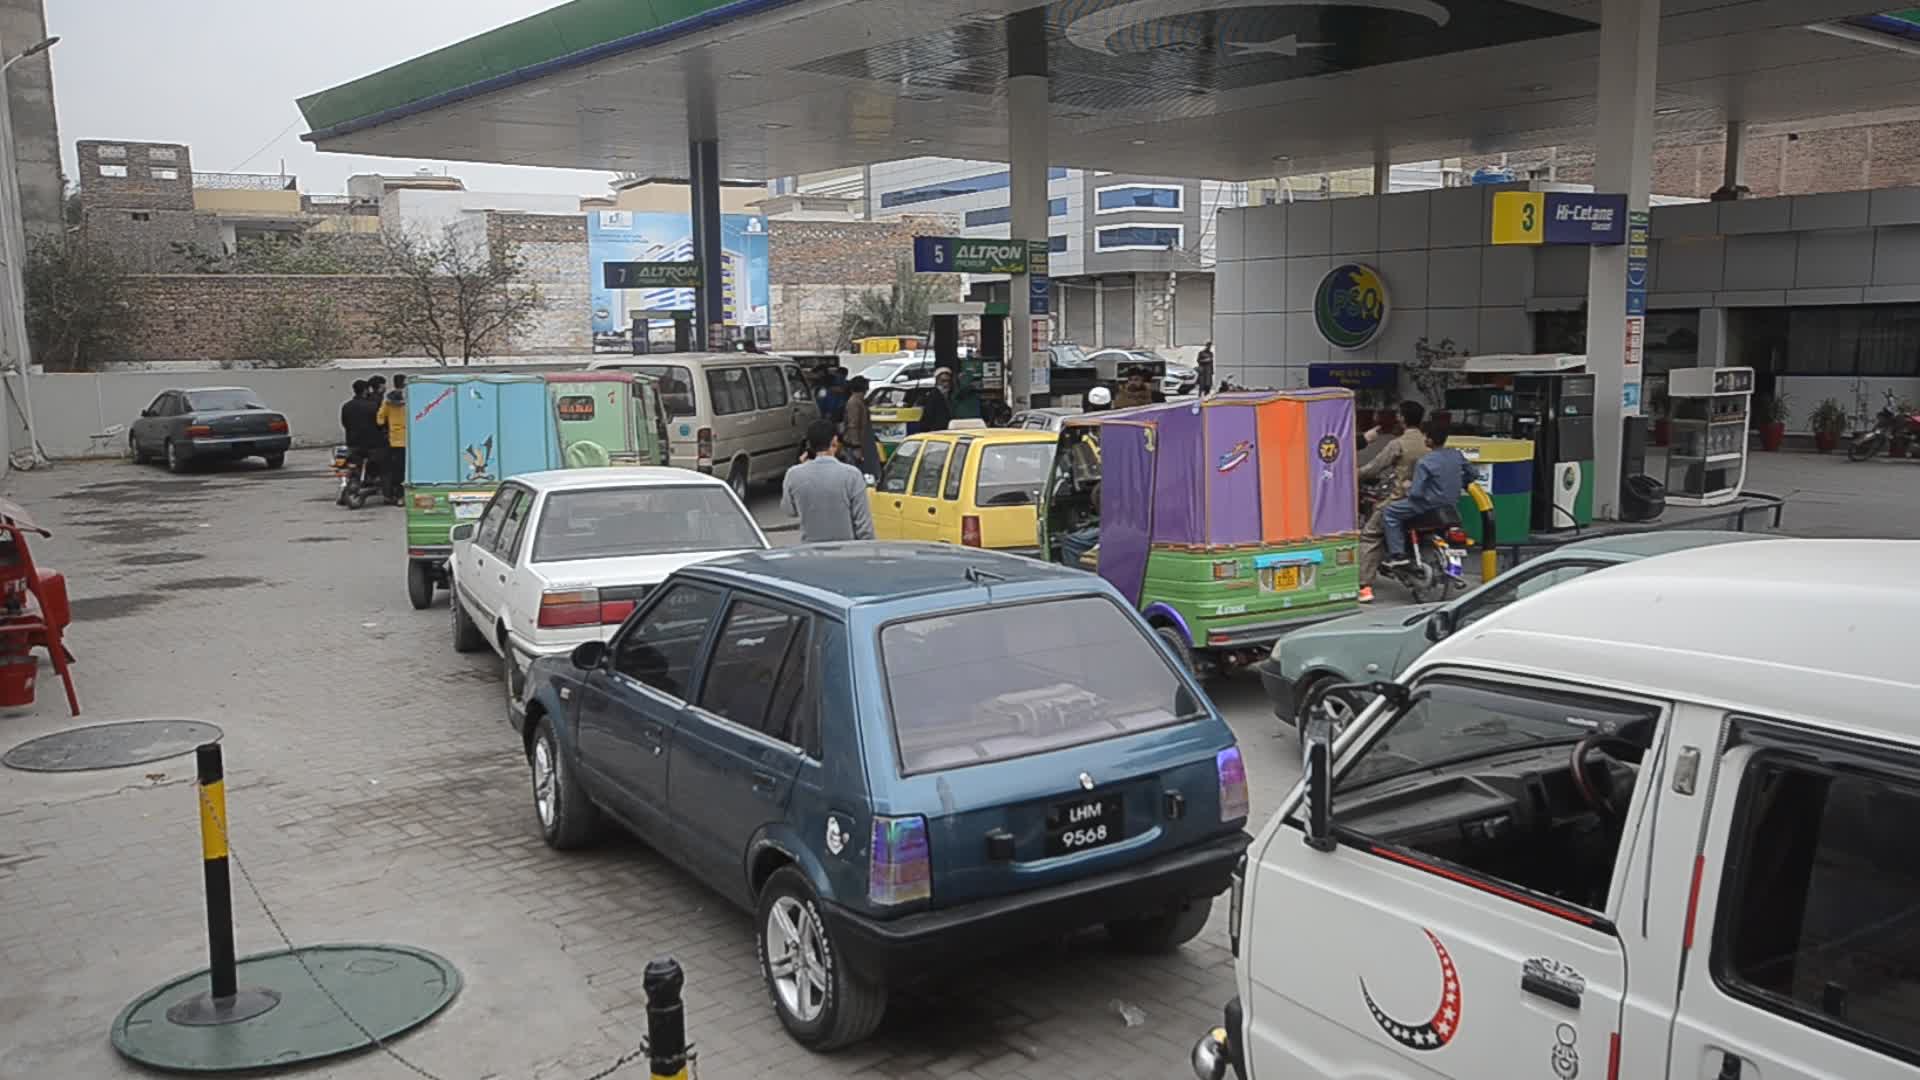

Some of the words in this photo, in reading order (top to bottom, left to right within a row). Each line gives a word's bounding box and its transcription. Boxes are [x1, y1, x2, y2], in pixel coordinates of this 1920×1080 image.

[1521, 203, 1535, 231] 3
[1556, 204, 1614, 220] Hi-Cetane
[934, 245, 944, 264] 5
[956, 245, 1022, 265] ALTRON
[639, 266, 698, 281] ALTRON
[1069, 802, 1102, 822] LHM
[1063, 825, 1107, 847] 9568
